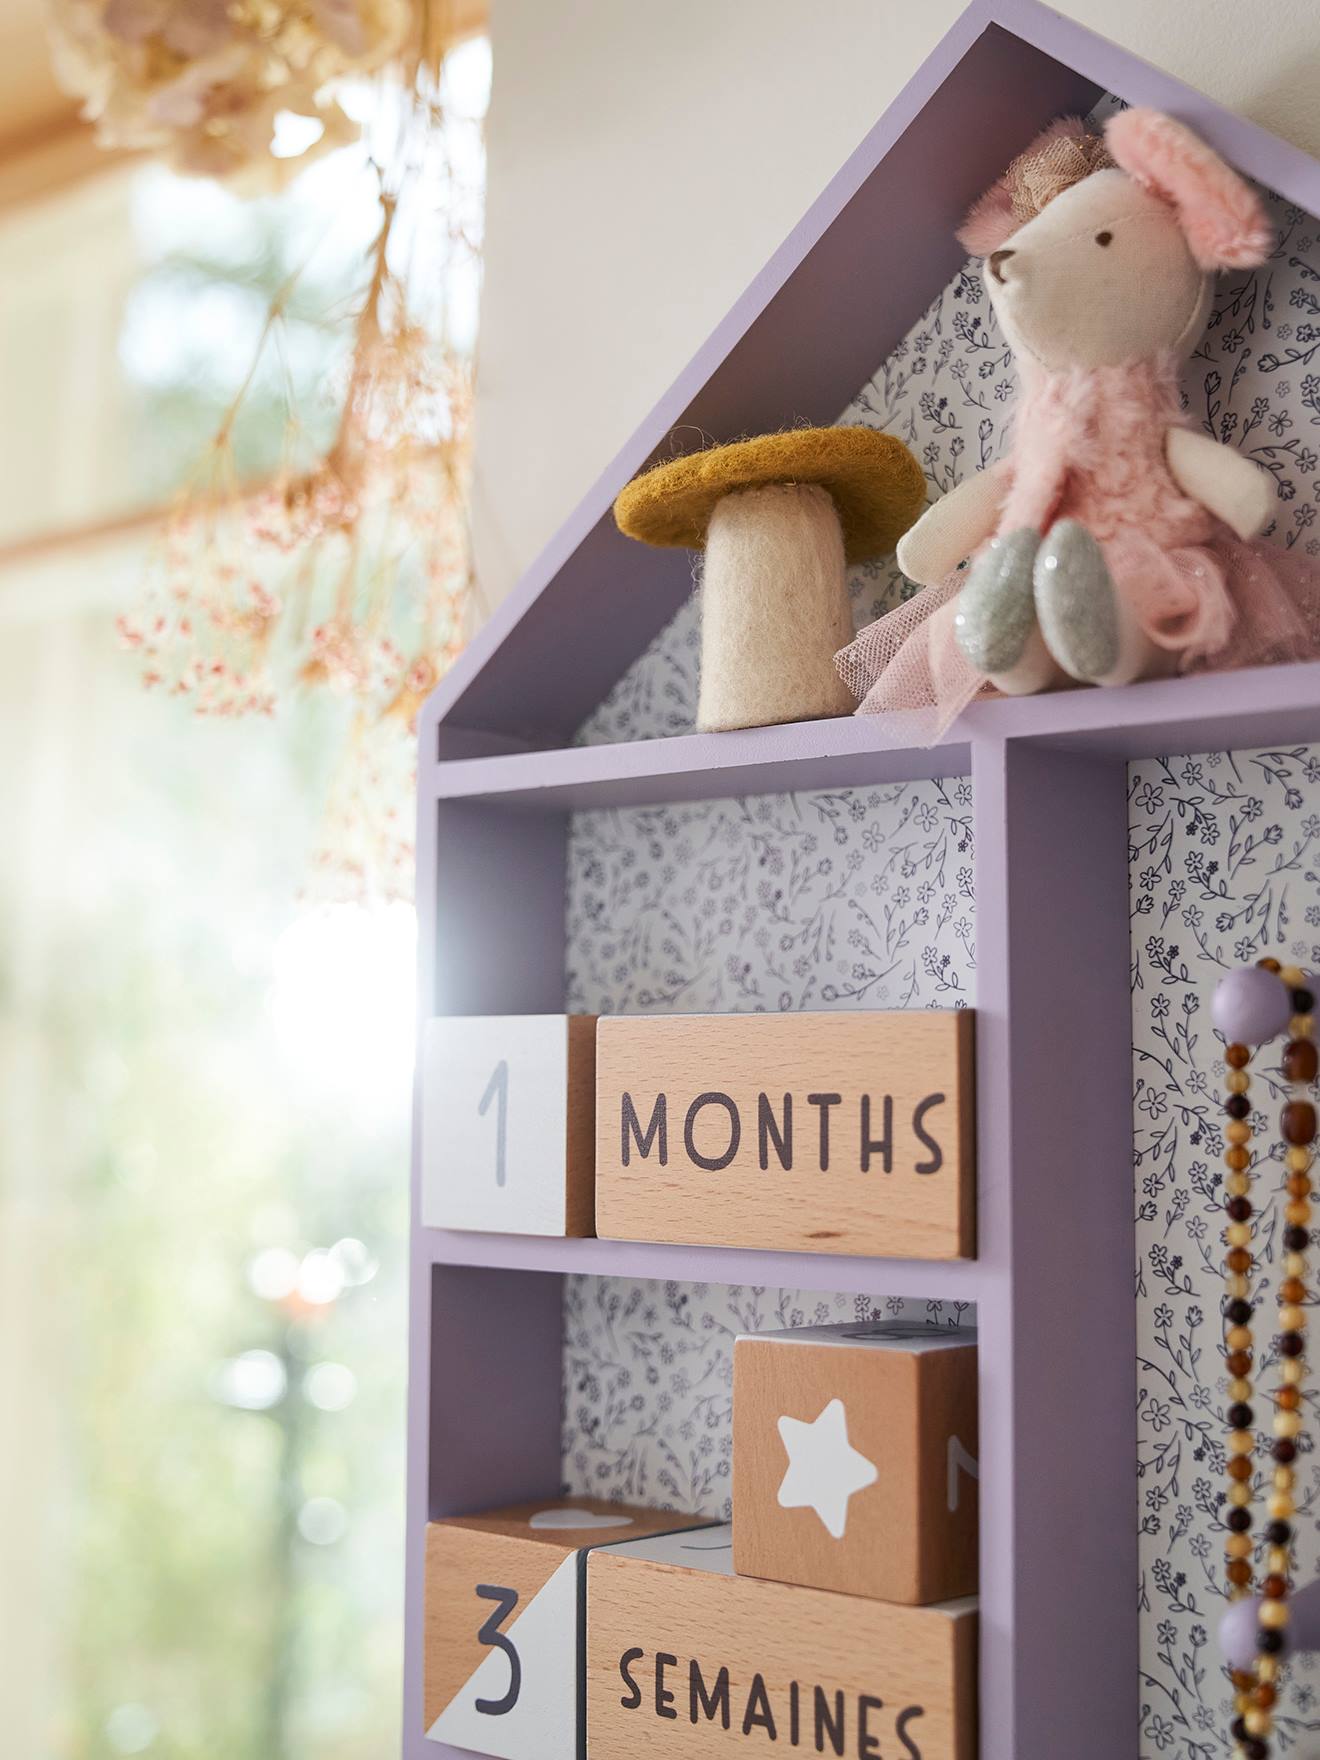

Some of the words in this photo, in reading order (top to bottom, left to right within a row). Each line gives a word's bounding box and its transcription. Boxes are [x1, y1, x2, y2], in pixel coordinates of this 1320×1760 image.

[478, 1060, 509, 1187] 1
[621, 1091, 946, 1174] MONTHS
[475, 1583, 521, 1716] 3
[619, 1647, 924, 1760] SEMAINES
